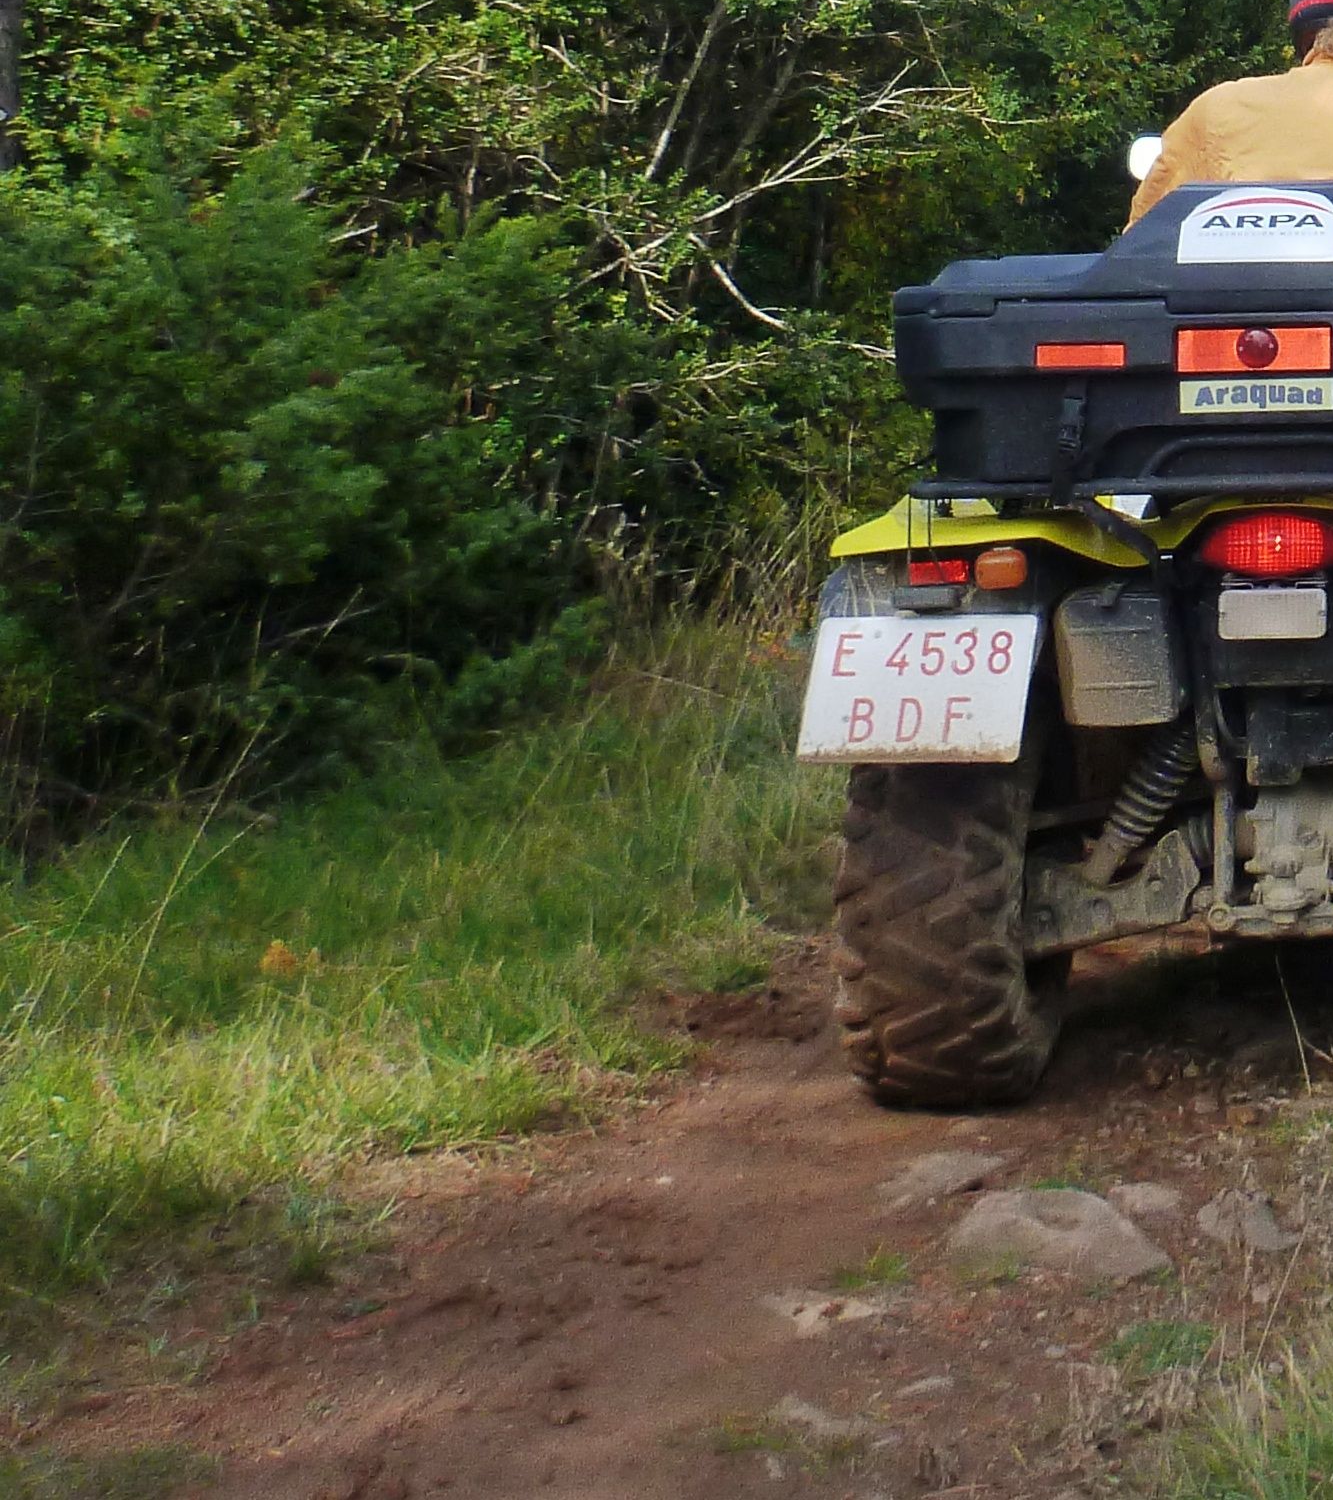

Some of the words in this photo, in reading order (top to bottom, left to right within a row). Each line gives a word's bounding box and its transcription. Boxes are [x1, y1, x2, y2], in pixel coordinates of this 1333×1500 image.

[1202, 214, 1323, 229] ARPA
[1195, 384, 1323, 409] Araquad
[832, 632, 863, 677] E
[885, 630, 1013, 676] 4538
